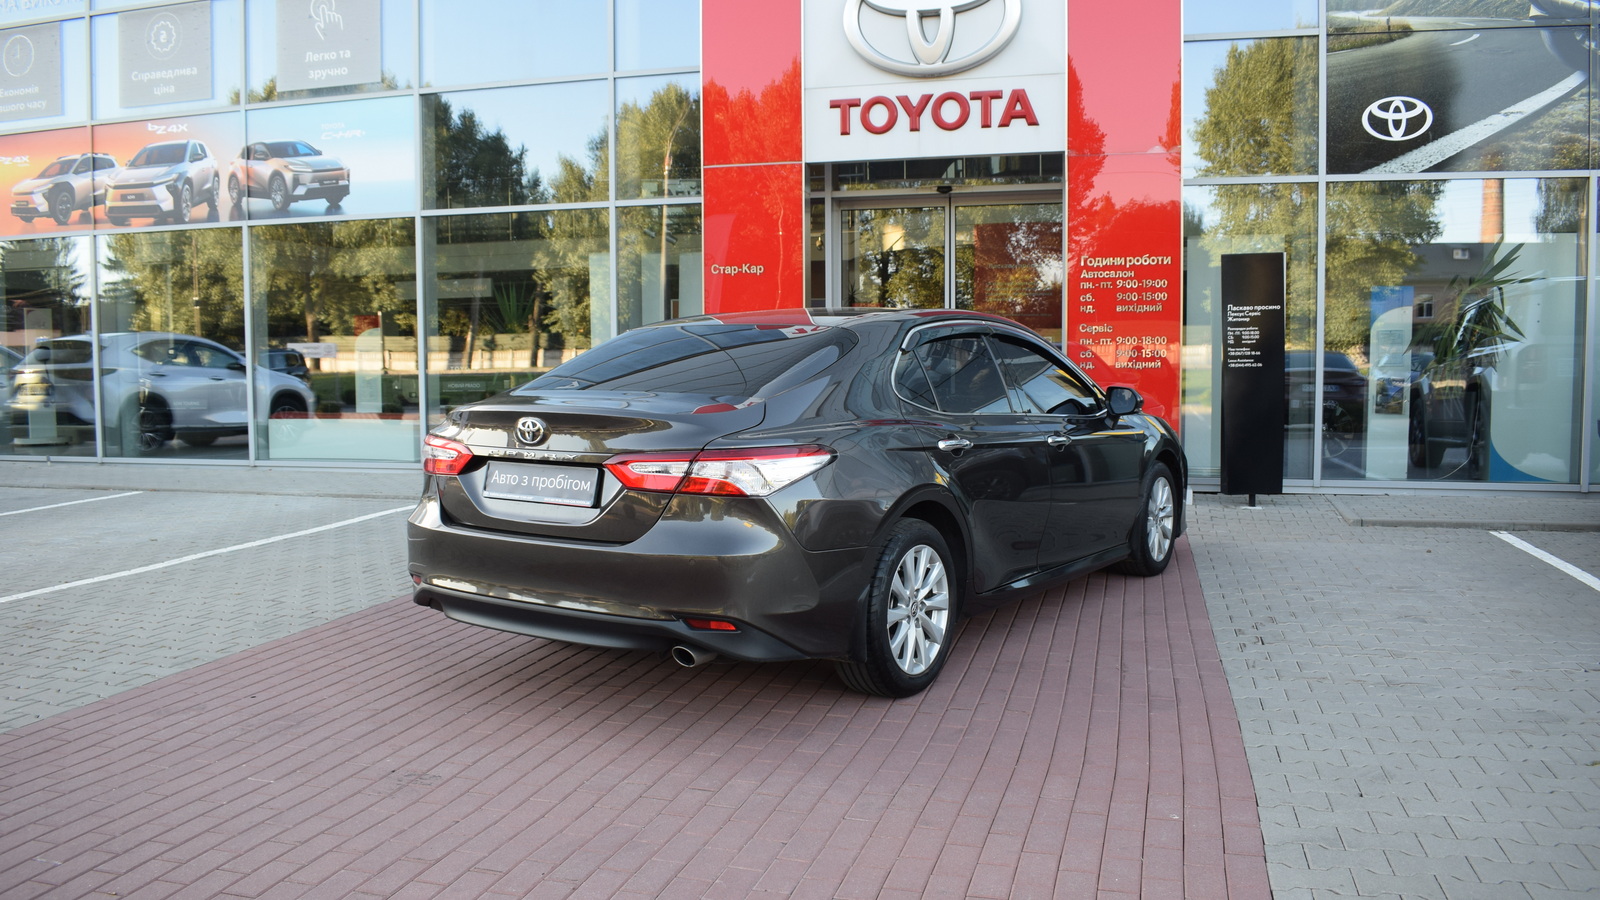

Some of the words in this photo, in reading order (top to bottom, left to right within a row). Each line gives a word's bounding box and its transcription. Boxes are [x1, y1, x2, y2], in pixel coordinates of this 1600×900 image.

[305, 52, 337, 62] Легко
[339, 50, 351, 58] та
[131, 67, 198, 82] Справедлива
[308, 67, 348, 80] зручно
[0, 84, 39, 97] Економія
[153, 84, 175, 95] ціна
[27, 100, 47, 110] часу
[830, 88, 1040, 136] TOYOTA
[1080, 255, 1124, 267] Години
[1126, 254, 1172, 268] роботи
[711, 263, 764, 276] Стар-Кар
[1080, 270, 1134, 278] Автосалон
[1116, 280, 1168, 288] 9:00-19:00
[1080, 293, 1095, 302] сб.
[1116, 292, 1168, 301] 9:00-15:00
[1080, 306, 1096, 314] нд.
[1116, 303, 1162, 312] вихідний
[1080, 324, 1113, 334] Сервіс
[1116, 336, 1168, 344] 9:00-18:00
[1080, 350, 1094, 358] сб.
[1116, 350, 1167, 358] 9:00-15:00
[1116, 360, 1161, 368] вихідний
[490, 470, 519, 485] Авто
[520, 476, 528, 486] з
[532, 474, 590, 491] пробігом
